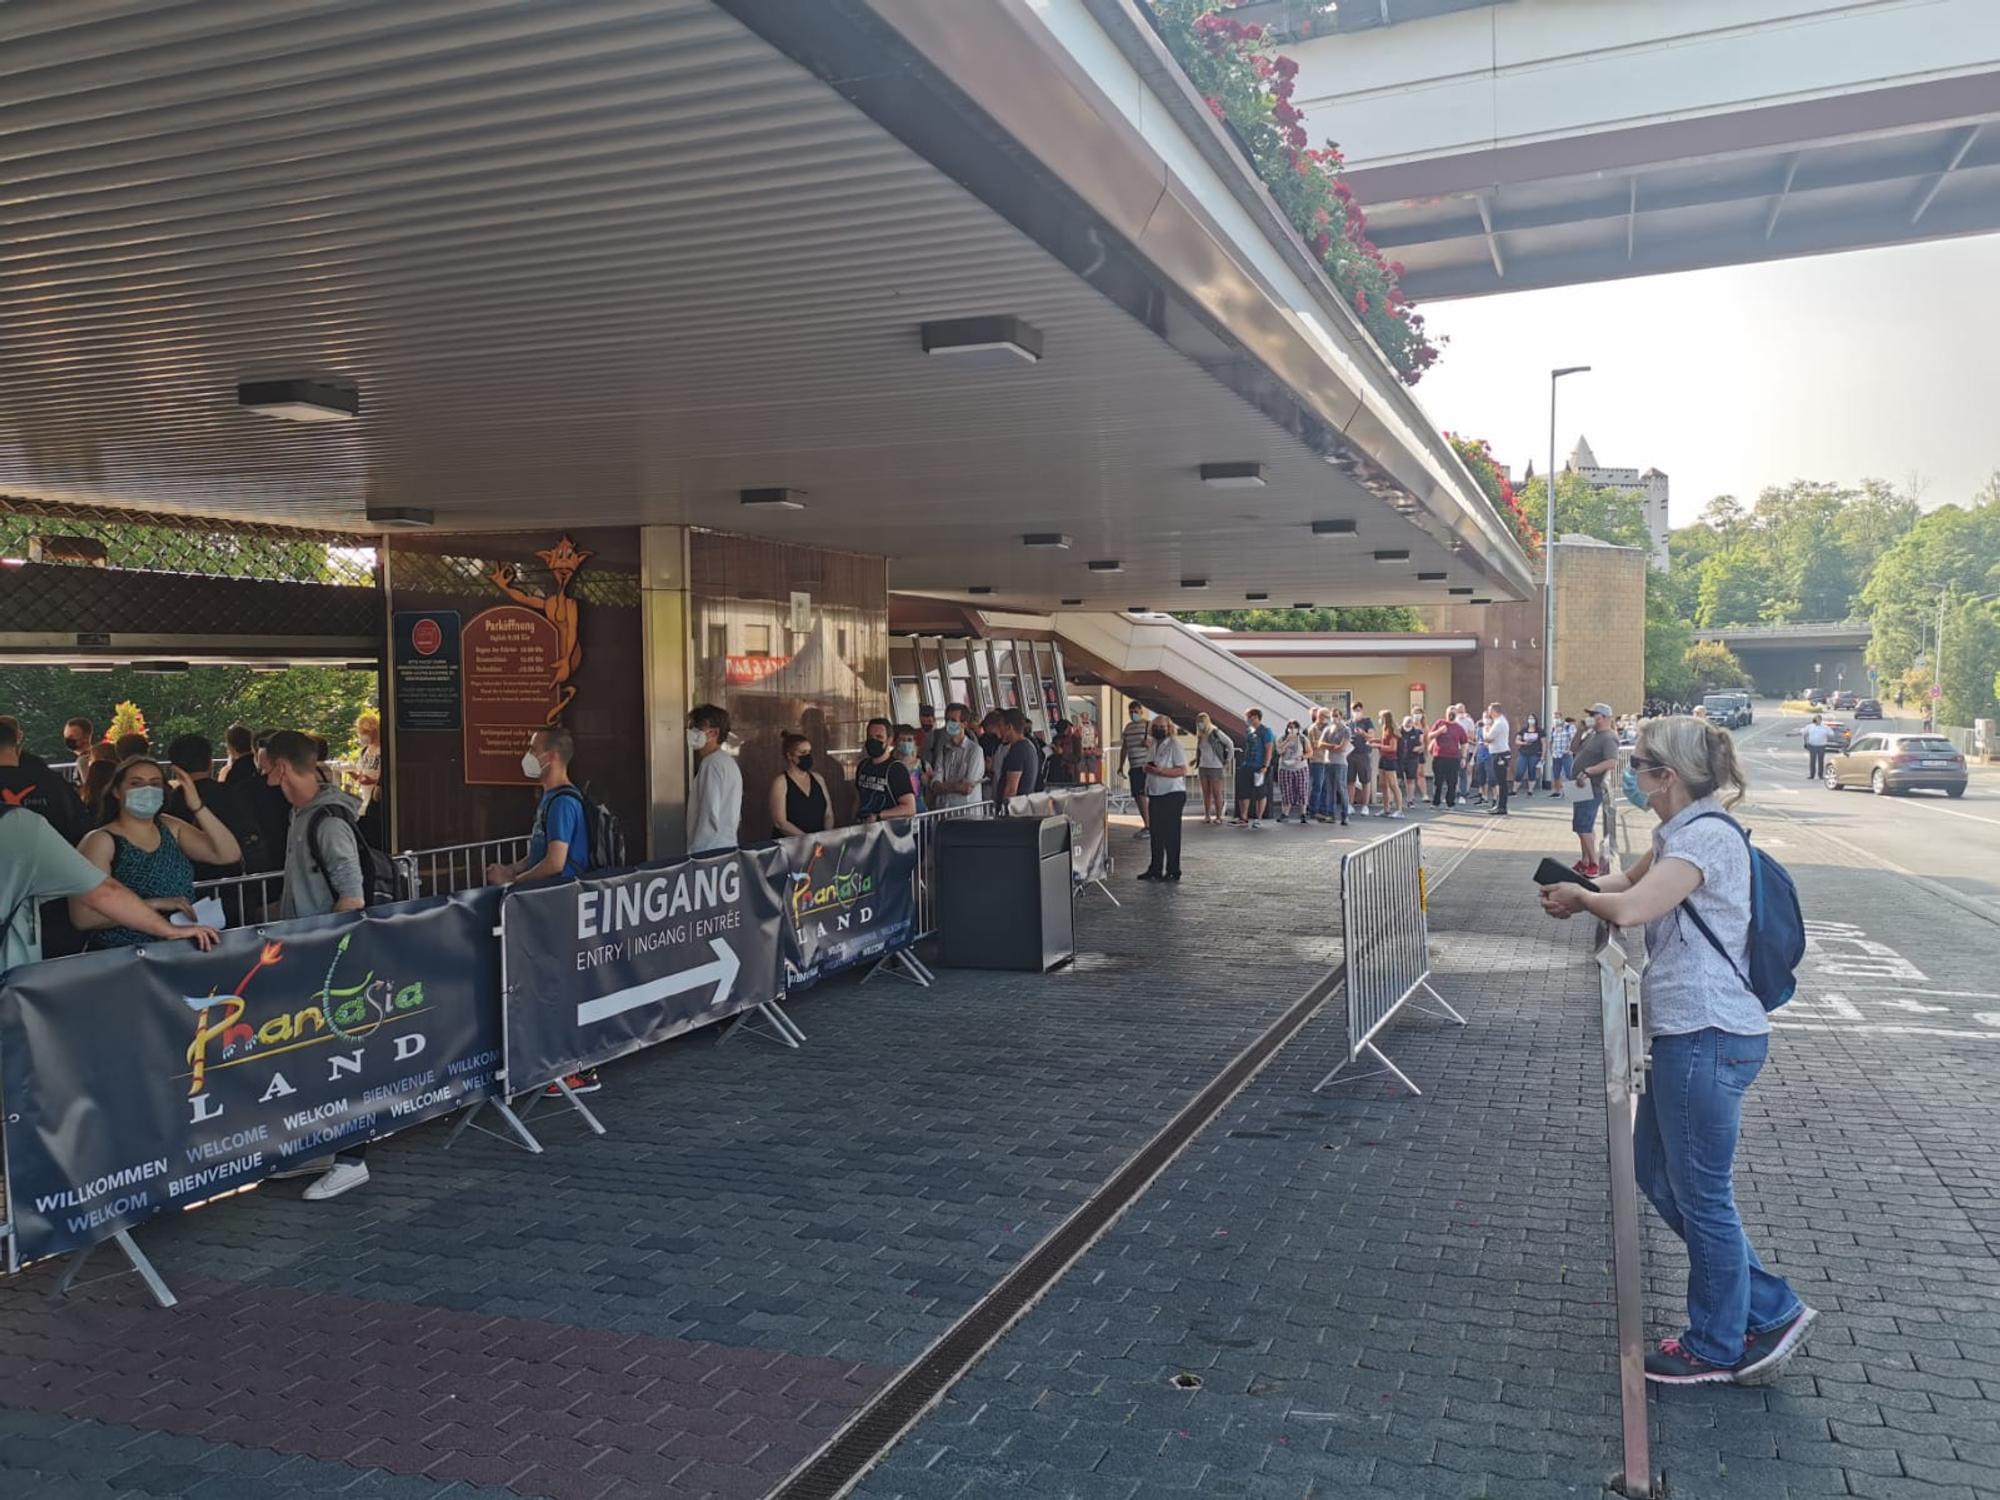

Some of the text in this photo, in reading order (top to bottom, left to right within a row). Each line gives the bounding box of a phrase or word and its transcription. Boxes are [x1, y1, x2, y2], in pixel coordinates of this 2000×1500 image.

[485, 619, 535, 634] Parköffnung
[577, 861, 741, 940] EINGANG
[791, 841, 872, 928] Phantasia
[796, 906, 873, 945] LAND
[576, 909, 741, 971] ENTRY INGANG ENTRÉE
[183, 932, 425, 1096] Phantasia
[188, 1033, 428, 1125] LAND
[35, 1157, 169, 1213] WILLKOMMEN
[186, 1125, 269, 1164] WELCOME
[283, 1098, 349, 1132] WELKOM
[362, 1070, 436, 1105] BIENVENUE
[66, 1191, 149, 1234] WELKOM
[168, 1151, 264, 1198] BIENVENUE
[278, 1112, 377, 1158] WILLKOMMEN
[389, 1085, 452, 1119] WELCOME
